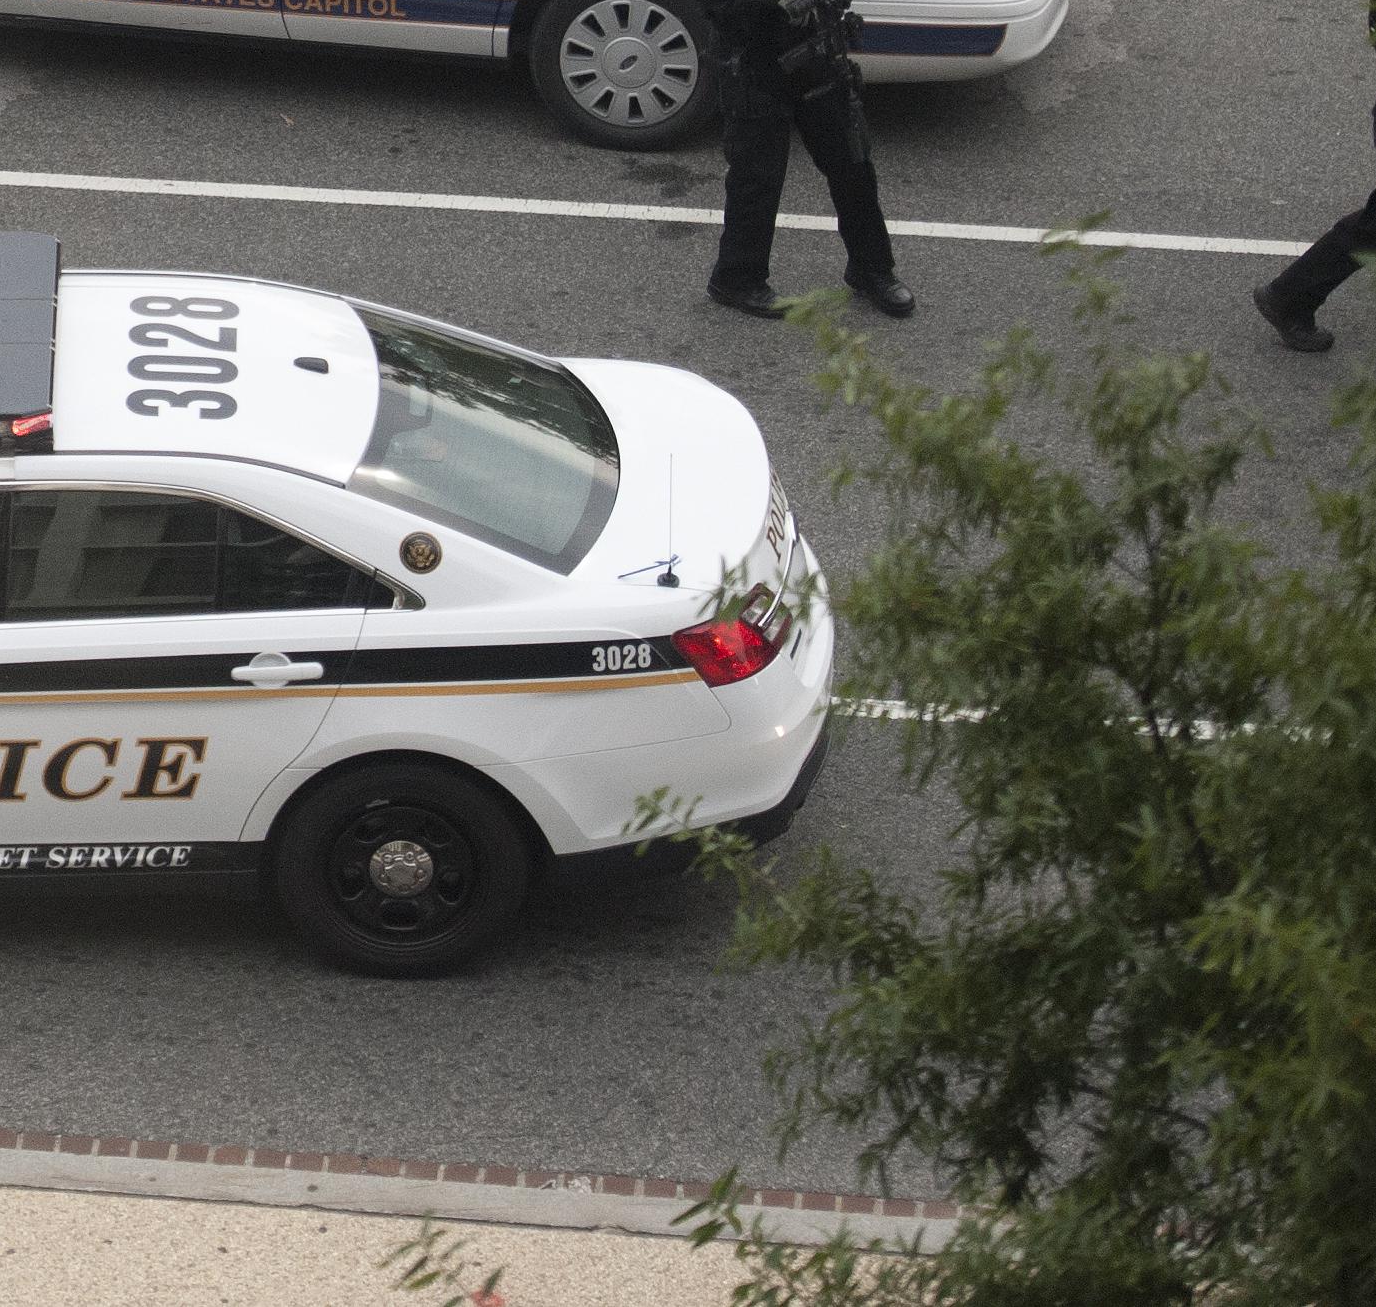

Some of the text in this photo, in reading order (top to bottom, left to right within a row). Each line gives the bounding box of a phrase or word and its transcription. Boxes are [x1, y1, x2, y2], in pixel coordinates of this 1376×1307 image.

[125, 295, 241, 421] 3028
[590, 643, 653, 672] 3028
[45, 845, 193, 869] SERVICE
